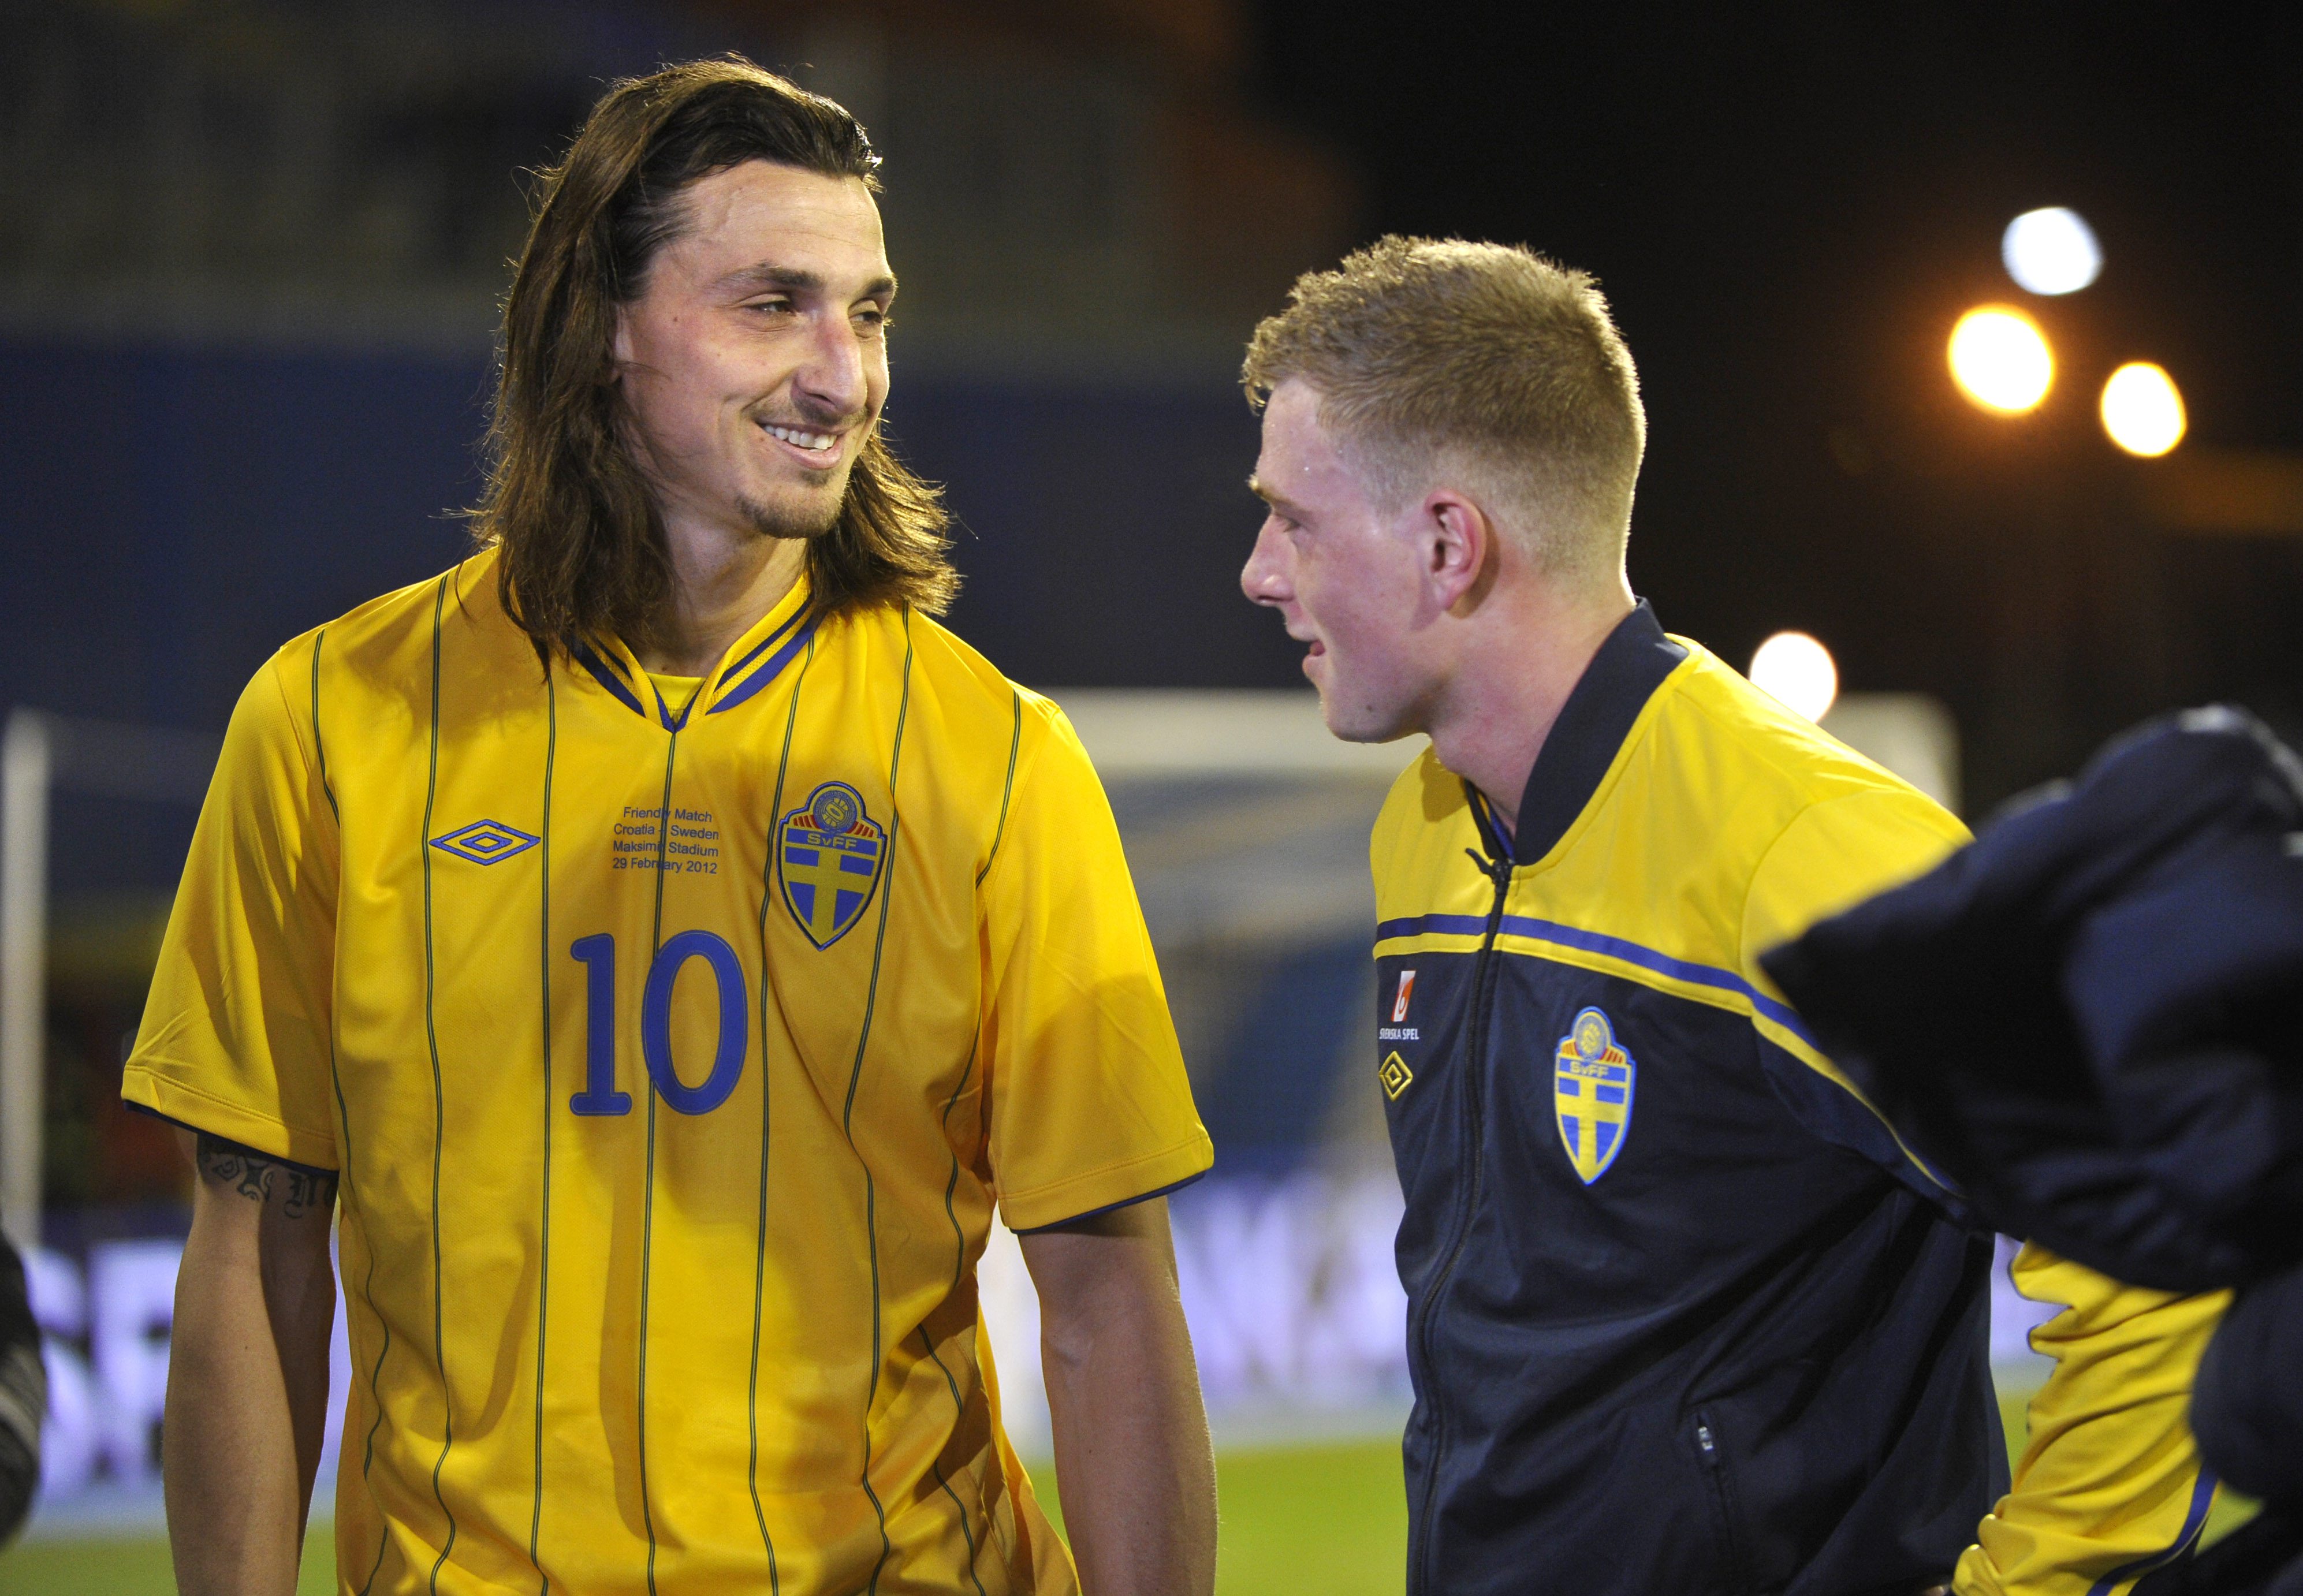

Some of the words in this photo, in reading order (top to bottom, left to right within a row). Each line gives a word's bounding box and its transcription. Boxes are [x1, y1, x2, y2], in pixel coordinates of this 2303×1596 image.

[674, 808, 712, 822] Match
[614, 823, 655, 834] Croatia
[670, 825, 719, 840] Sweden
[669, 842, 718, 856] Stadium
[613, 857, 627, 868] 29
[687, 860, 717, 874] 2012
[569, 929, 748, 1117] 10
[1402, 1028, 1419, 1039] SPEL
